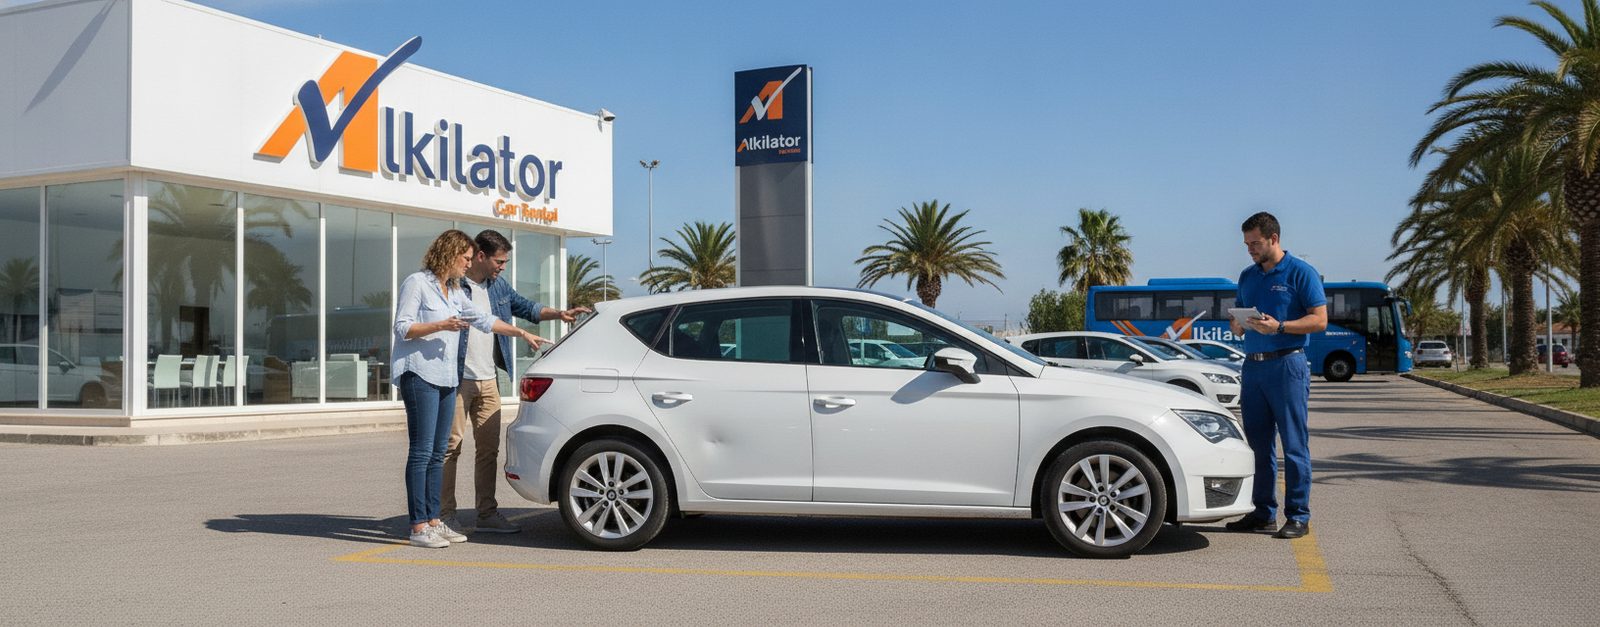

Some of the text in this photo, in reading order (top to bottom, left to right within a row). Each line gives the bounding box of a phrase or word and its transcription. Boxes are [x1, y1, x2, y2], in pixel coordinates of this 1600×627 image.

[256, 50, 563, 200] Alkilator
[737, 134, 801, 153] Alkilator
[495, 198, 517, 216] Car
